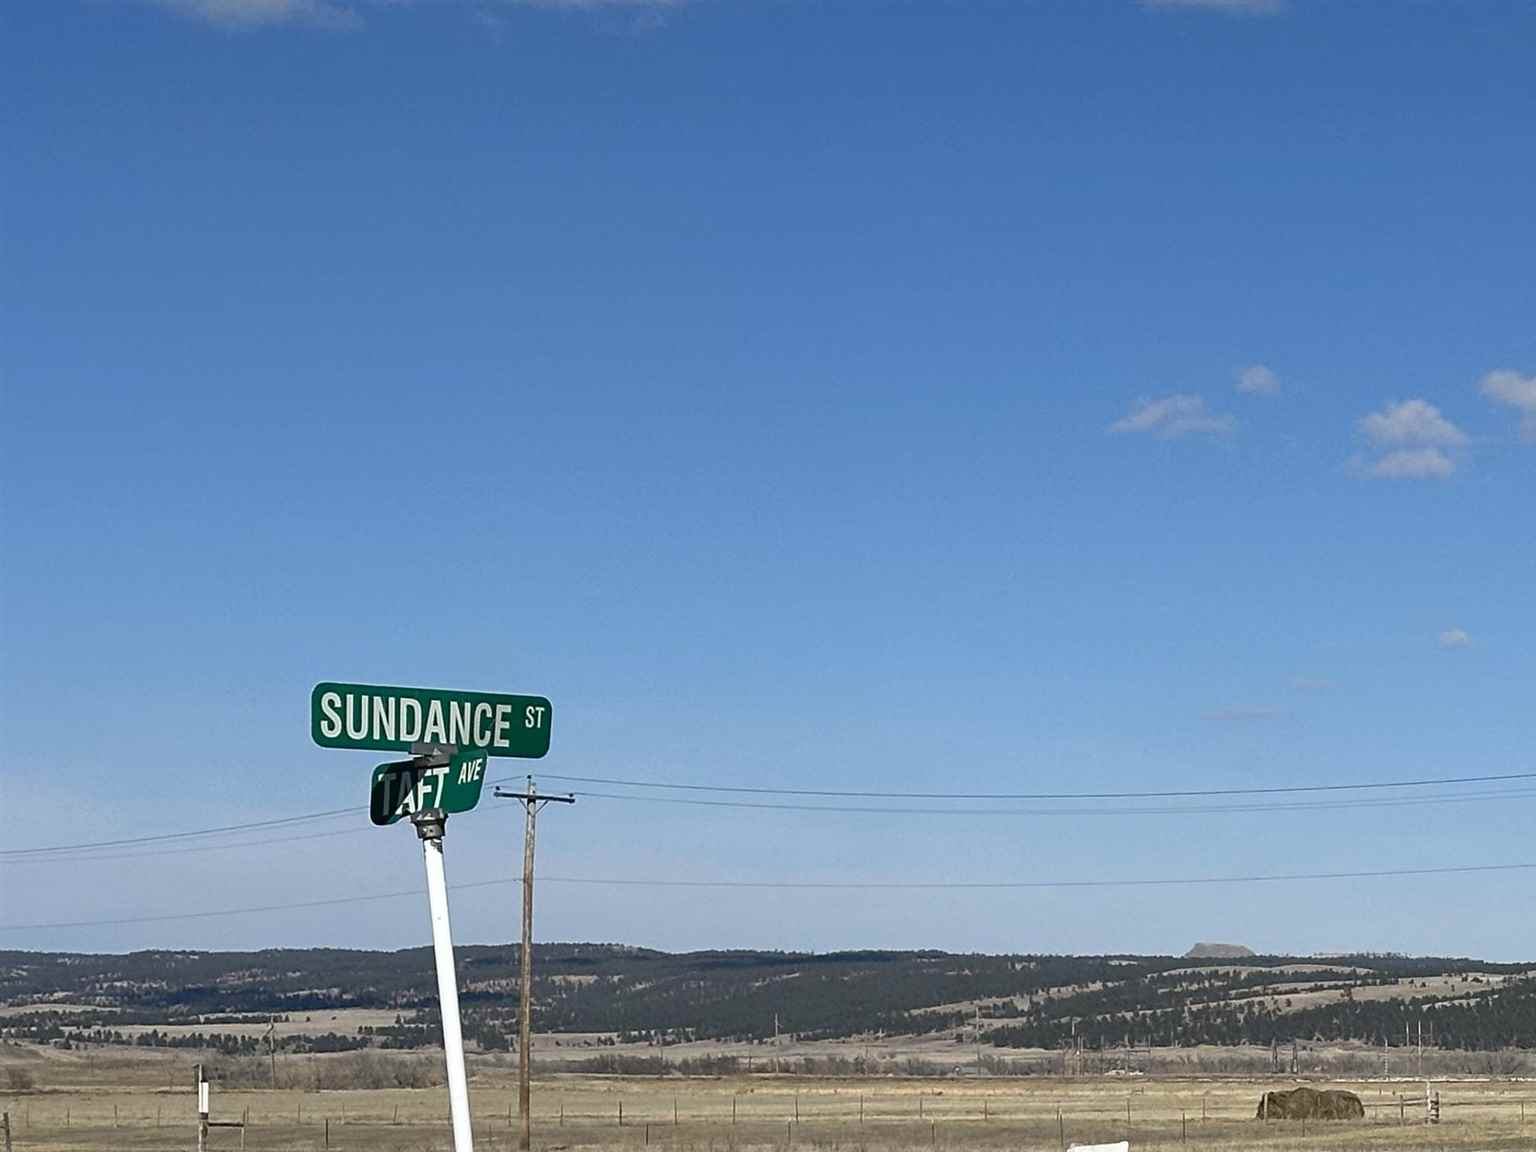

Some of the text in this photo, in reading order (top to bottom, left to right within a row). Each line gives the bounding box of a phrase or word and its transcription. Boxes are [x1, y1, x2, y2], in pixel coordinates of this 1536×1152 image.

[320, 691, 545, 748] SUNDANCE ST
[378, 758, 483, 816] TAFT AVE
